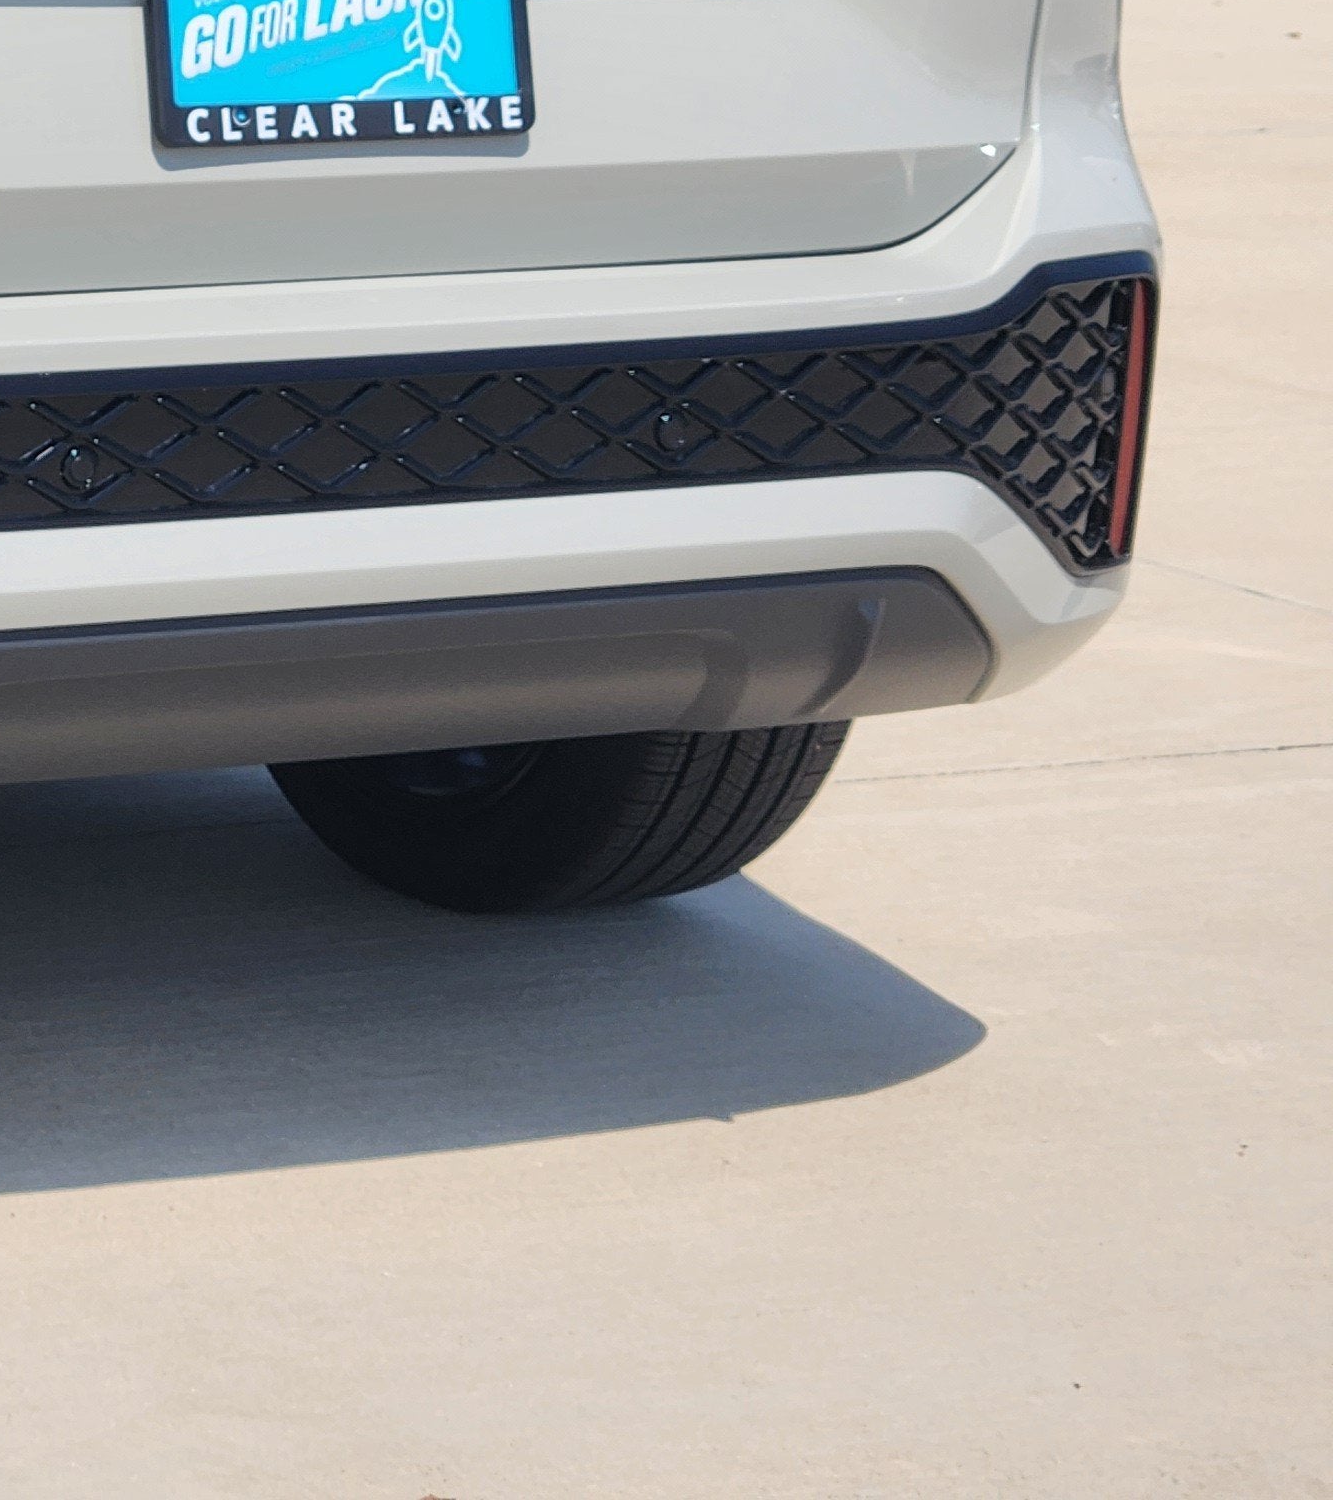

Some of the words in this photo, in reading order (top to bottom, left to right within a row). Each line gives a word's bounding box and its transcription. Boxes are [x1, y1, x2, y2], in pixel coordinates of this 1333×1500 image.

[181, 4, 248, 80] GO
[186, 104, 358, 143] CLEAR
[393, 96, 524, 135] LAKE
